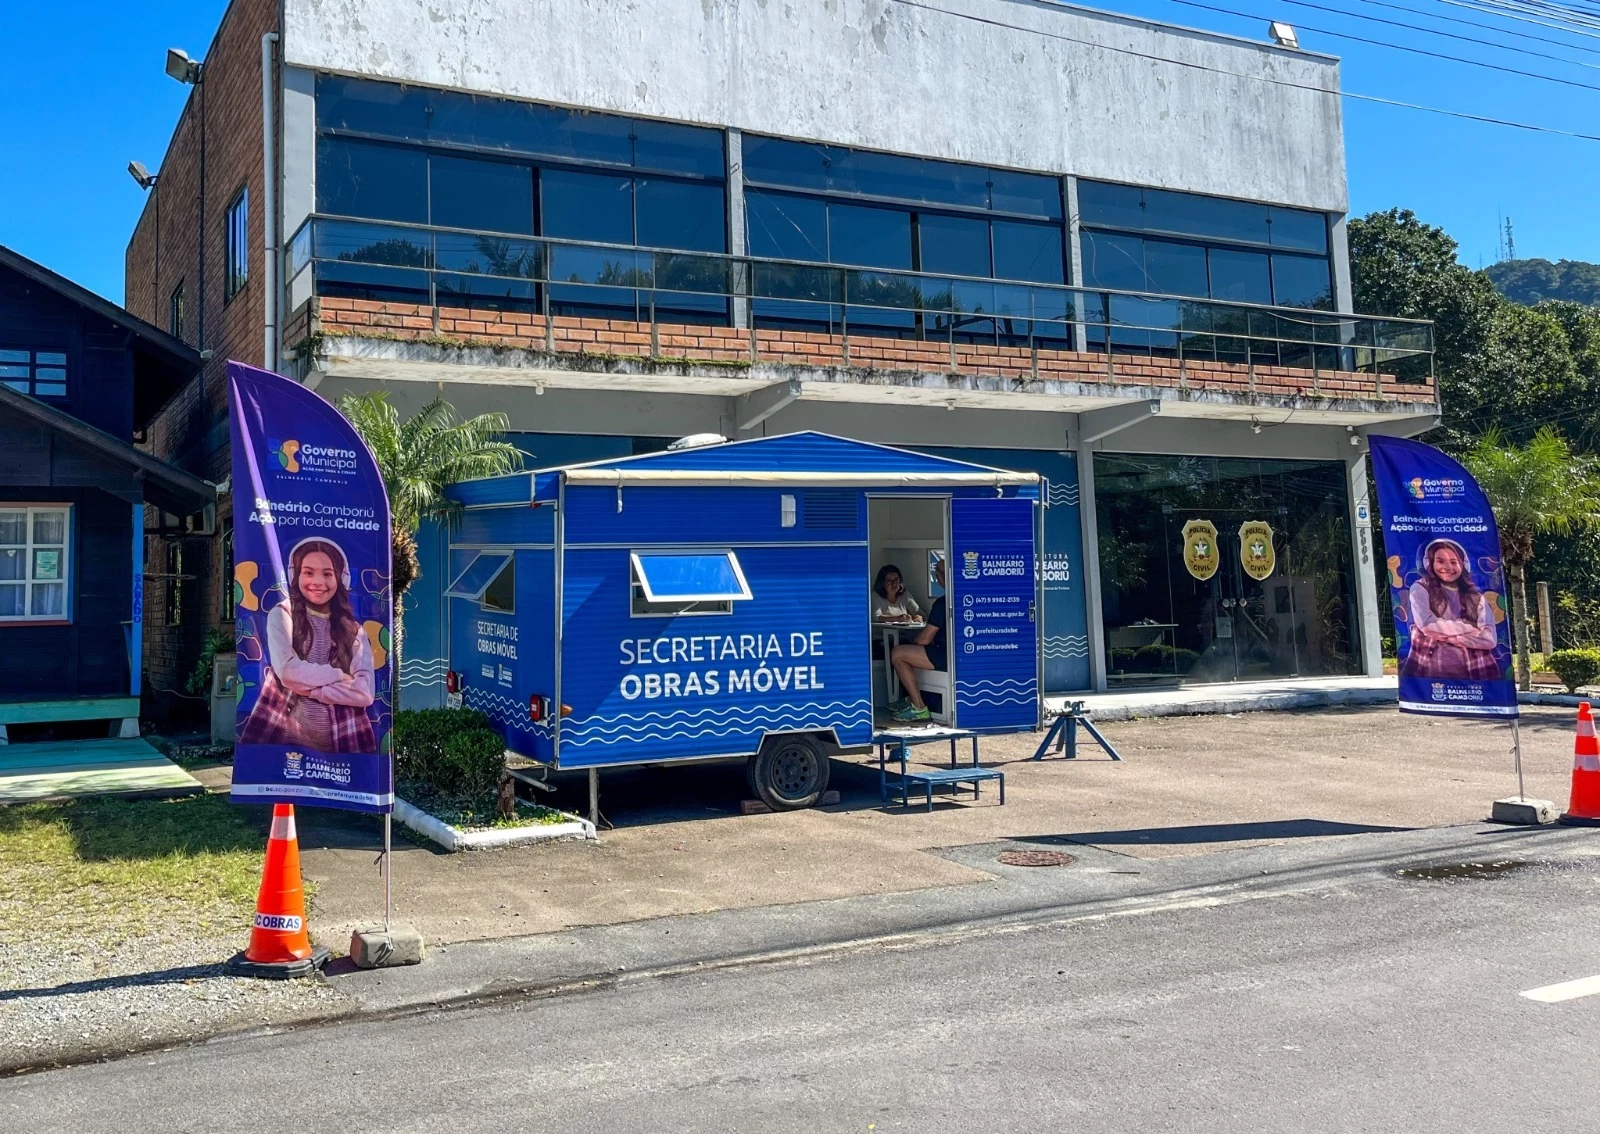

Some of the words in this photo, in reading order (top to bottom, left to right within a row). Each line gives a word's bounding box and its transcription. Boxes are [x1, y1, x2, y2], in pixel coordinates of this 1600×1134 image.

[302, 444, 356, 459] Governo
[302, 454, 357, 470] Municipal
[1424, 479, 1464, 487] Governo
[1424, 485, 1465, 494] Municipal
[255, 498, 311, 513] Balneário
[313, 502, 374, 518] Camboriú
[249, 511, 277, 526] Ação
[279, 515, 300, 527] por
[302, 516, 332, 528] toda
[334, 518, 380, 531] Cidade
[1393, 515, 1436, 524] Balneário
[1390, 523, 1414, 532] Ação
[1431, 525, 1452, 533] toda
[1453, 524, 1488, 532] Cidade
[1193, 564, 1211, 572] CIVIL
[477, 621, 510, 640] SECRETARIA
[510, 627, 518, 641] DE
[477, 639, 496, 655] OBRAS
[497, 640, 518, 660] MÓVEL
[619, 634, 783, 665] SECRETARIA
[790, 632, 824, 657] DE
[620, 670, 720, 700] OBRAS
[728, 660, 825, 694] MÓVEL
[263, 916, 300, 929] OBRAS
